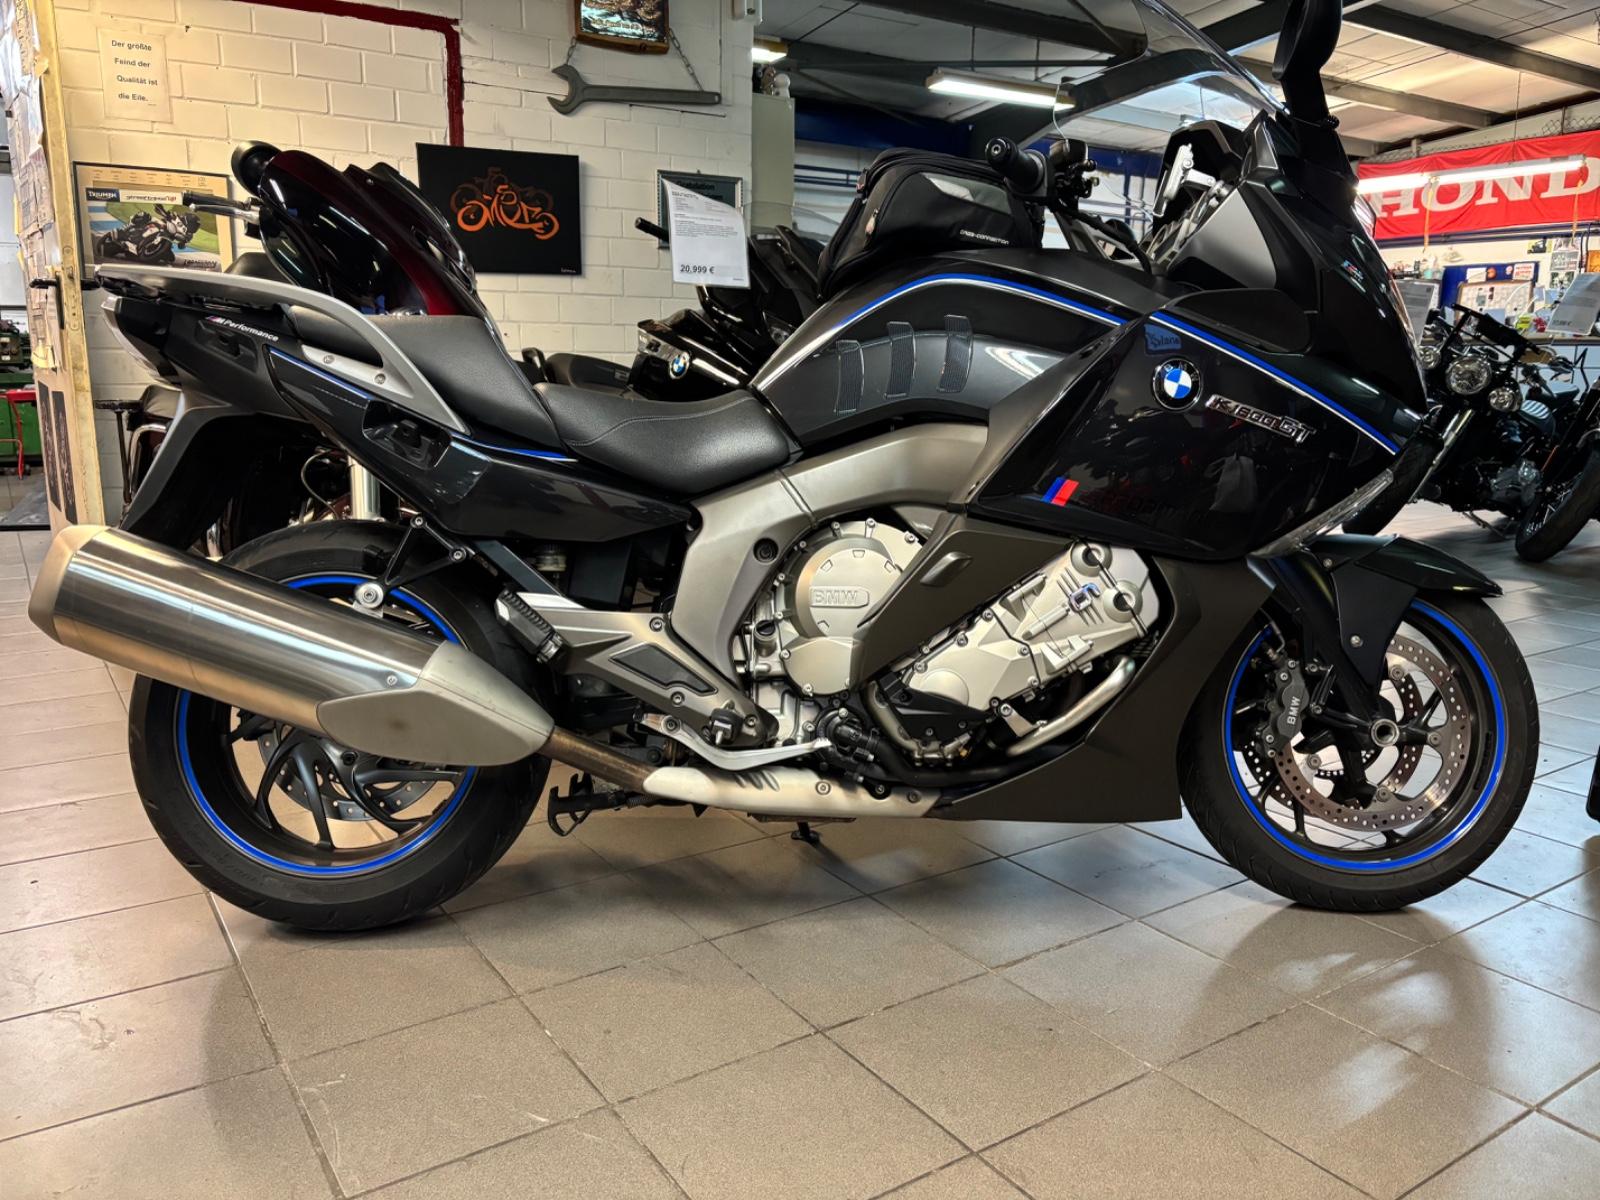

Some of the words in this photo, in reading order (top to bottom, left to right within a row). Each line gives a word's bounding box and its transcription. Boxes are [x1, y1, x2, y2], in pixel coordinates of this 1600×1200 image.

[111, 39, 125, 48] Der
[114, 56, 136, 65] Feind
[137, 60, 151, 68] der
[116, 74, 147, 85] Qualität
[118, 92, 130, 100] die
[679, 263, 708, 275] 20.999
[708, 265, 716, 275] €
[224, 320, 279, 341] Performance
[814, 589, 859, 605] BMW
[1287, 697, 1300, 725] BMW
